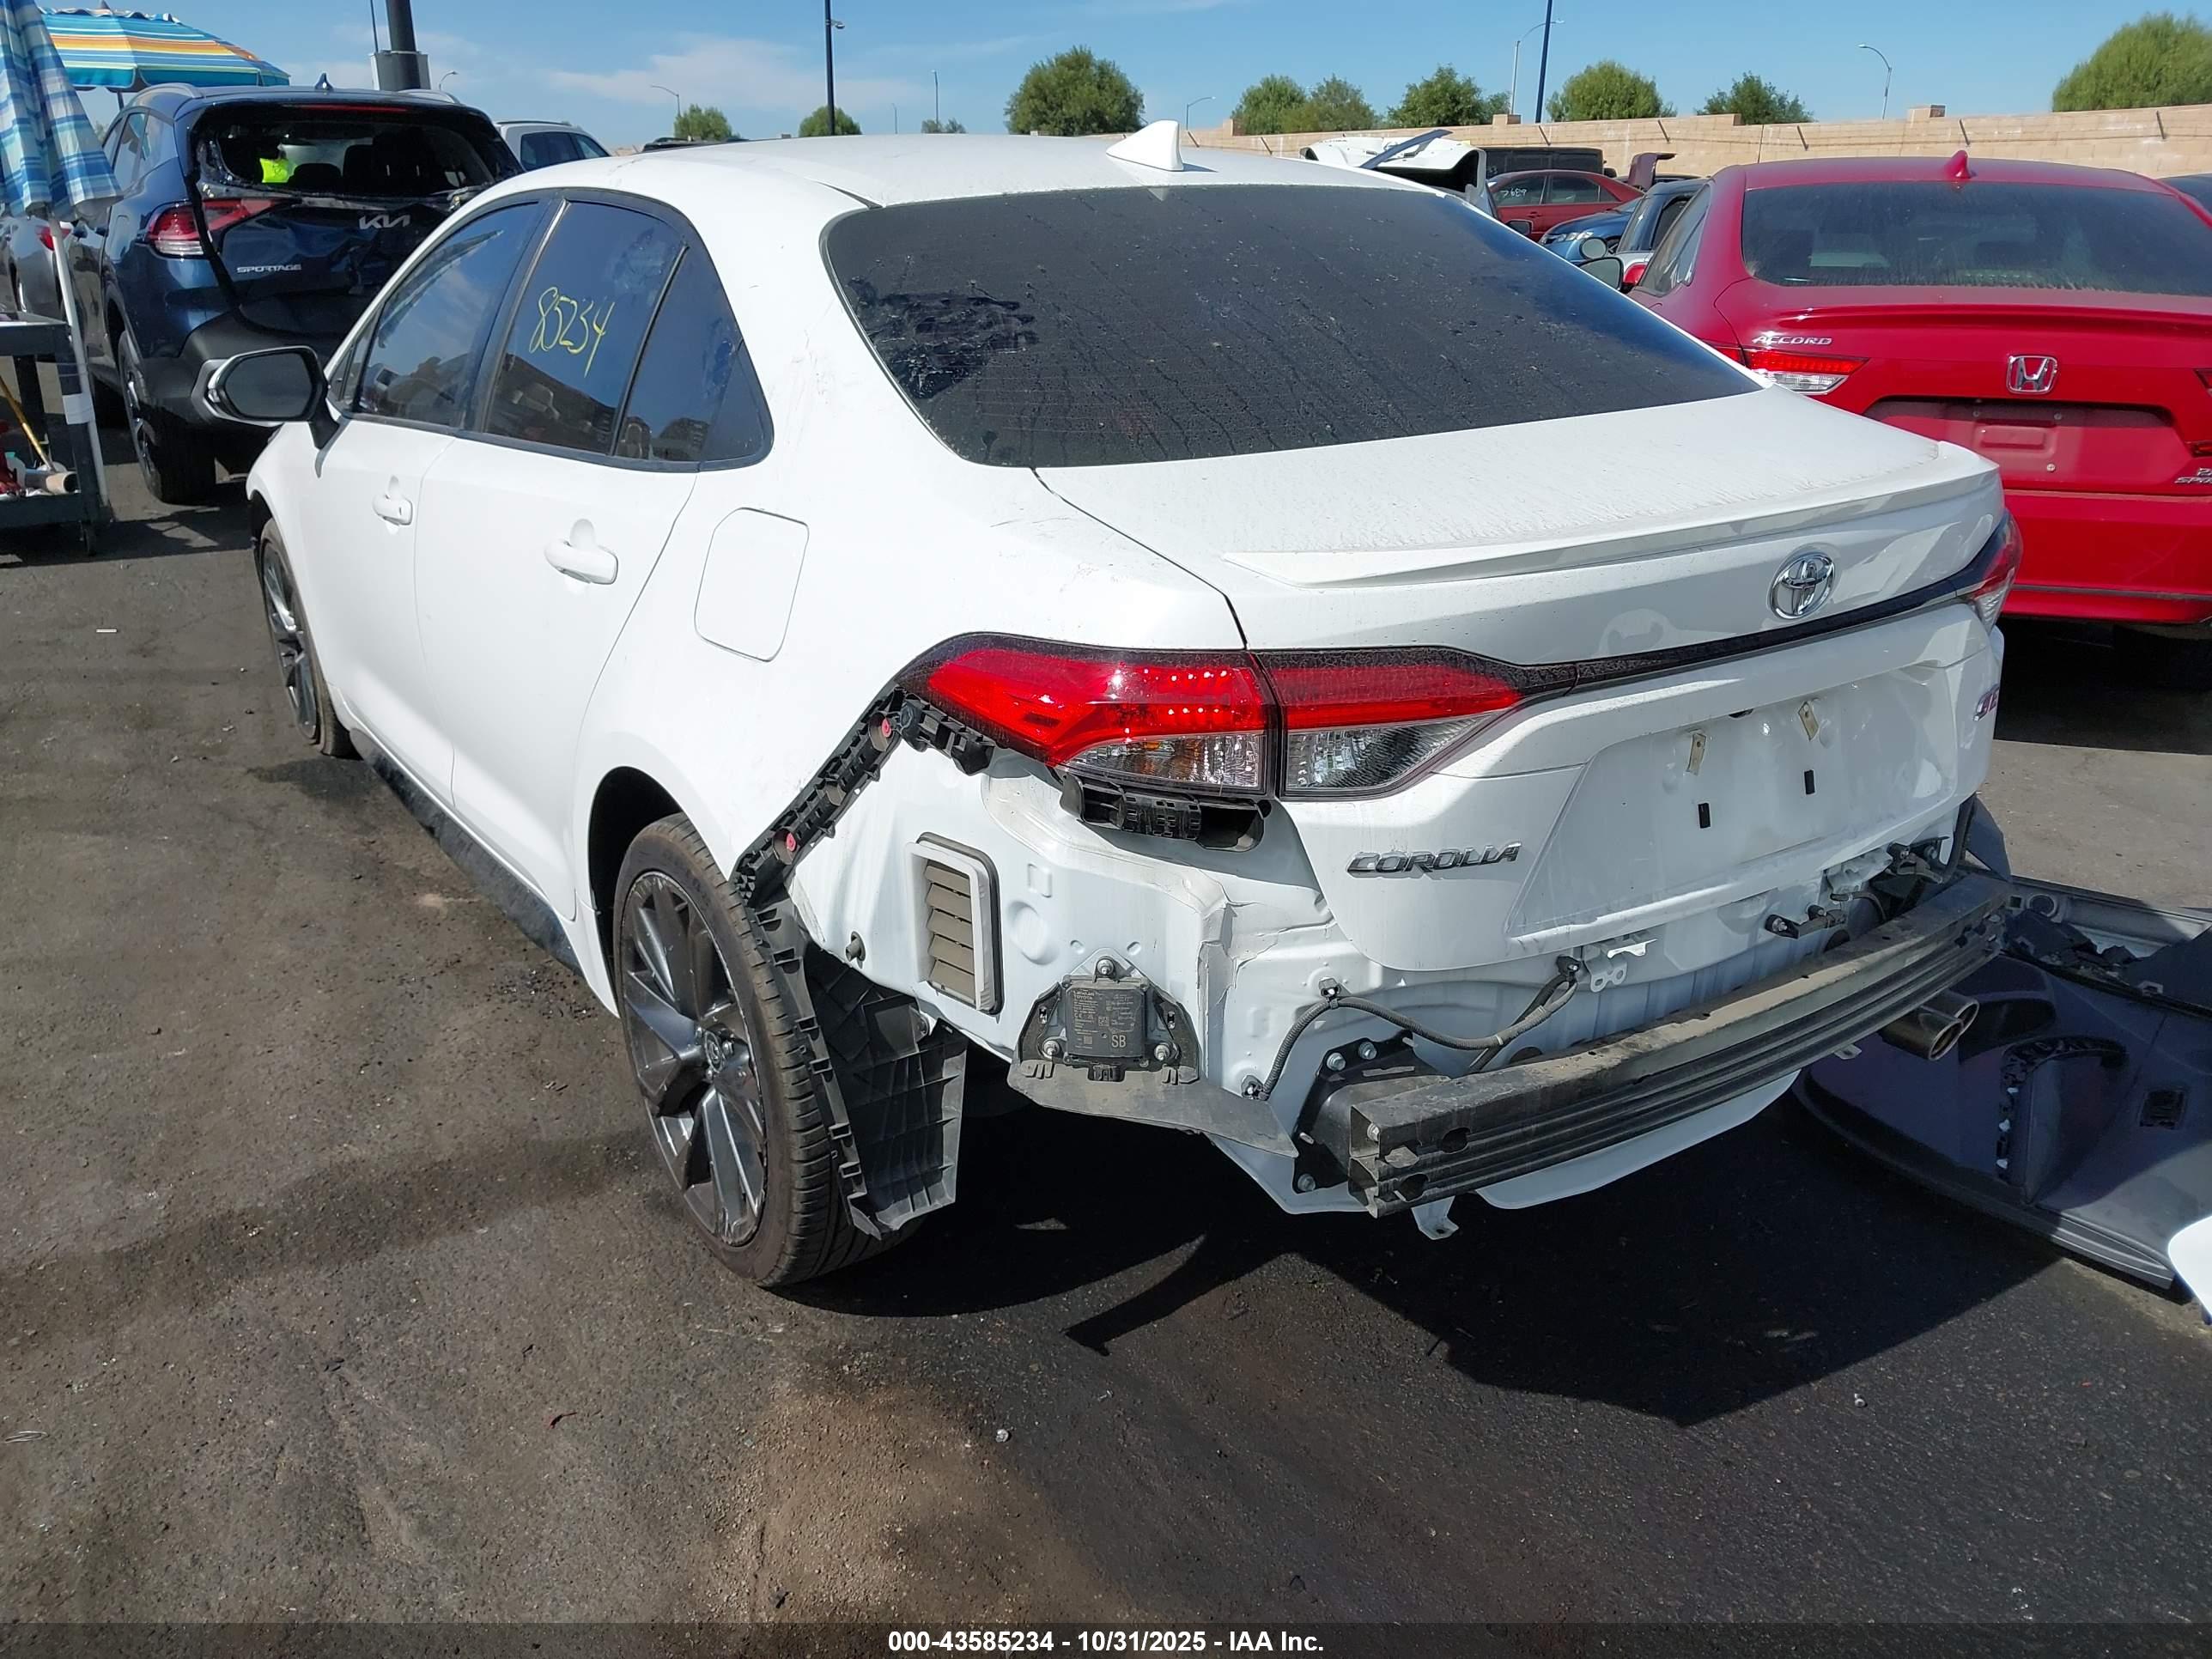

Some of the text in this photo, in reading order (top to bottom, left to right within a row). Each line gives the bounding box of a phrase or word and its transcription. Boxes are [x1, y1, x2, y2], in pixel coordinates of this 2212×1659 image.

[359, 214, 411, 229] KIA
[236, 264, 301, 274] SPORTAGE
[1752, 335, 1832, 345] ACCORD
[1346, 840, 1522, 874] COROLLA
[1111, 1034, 1127, 1048] SB
